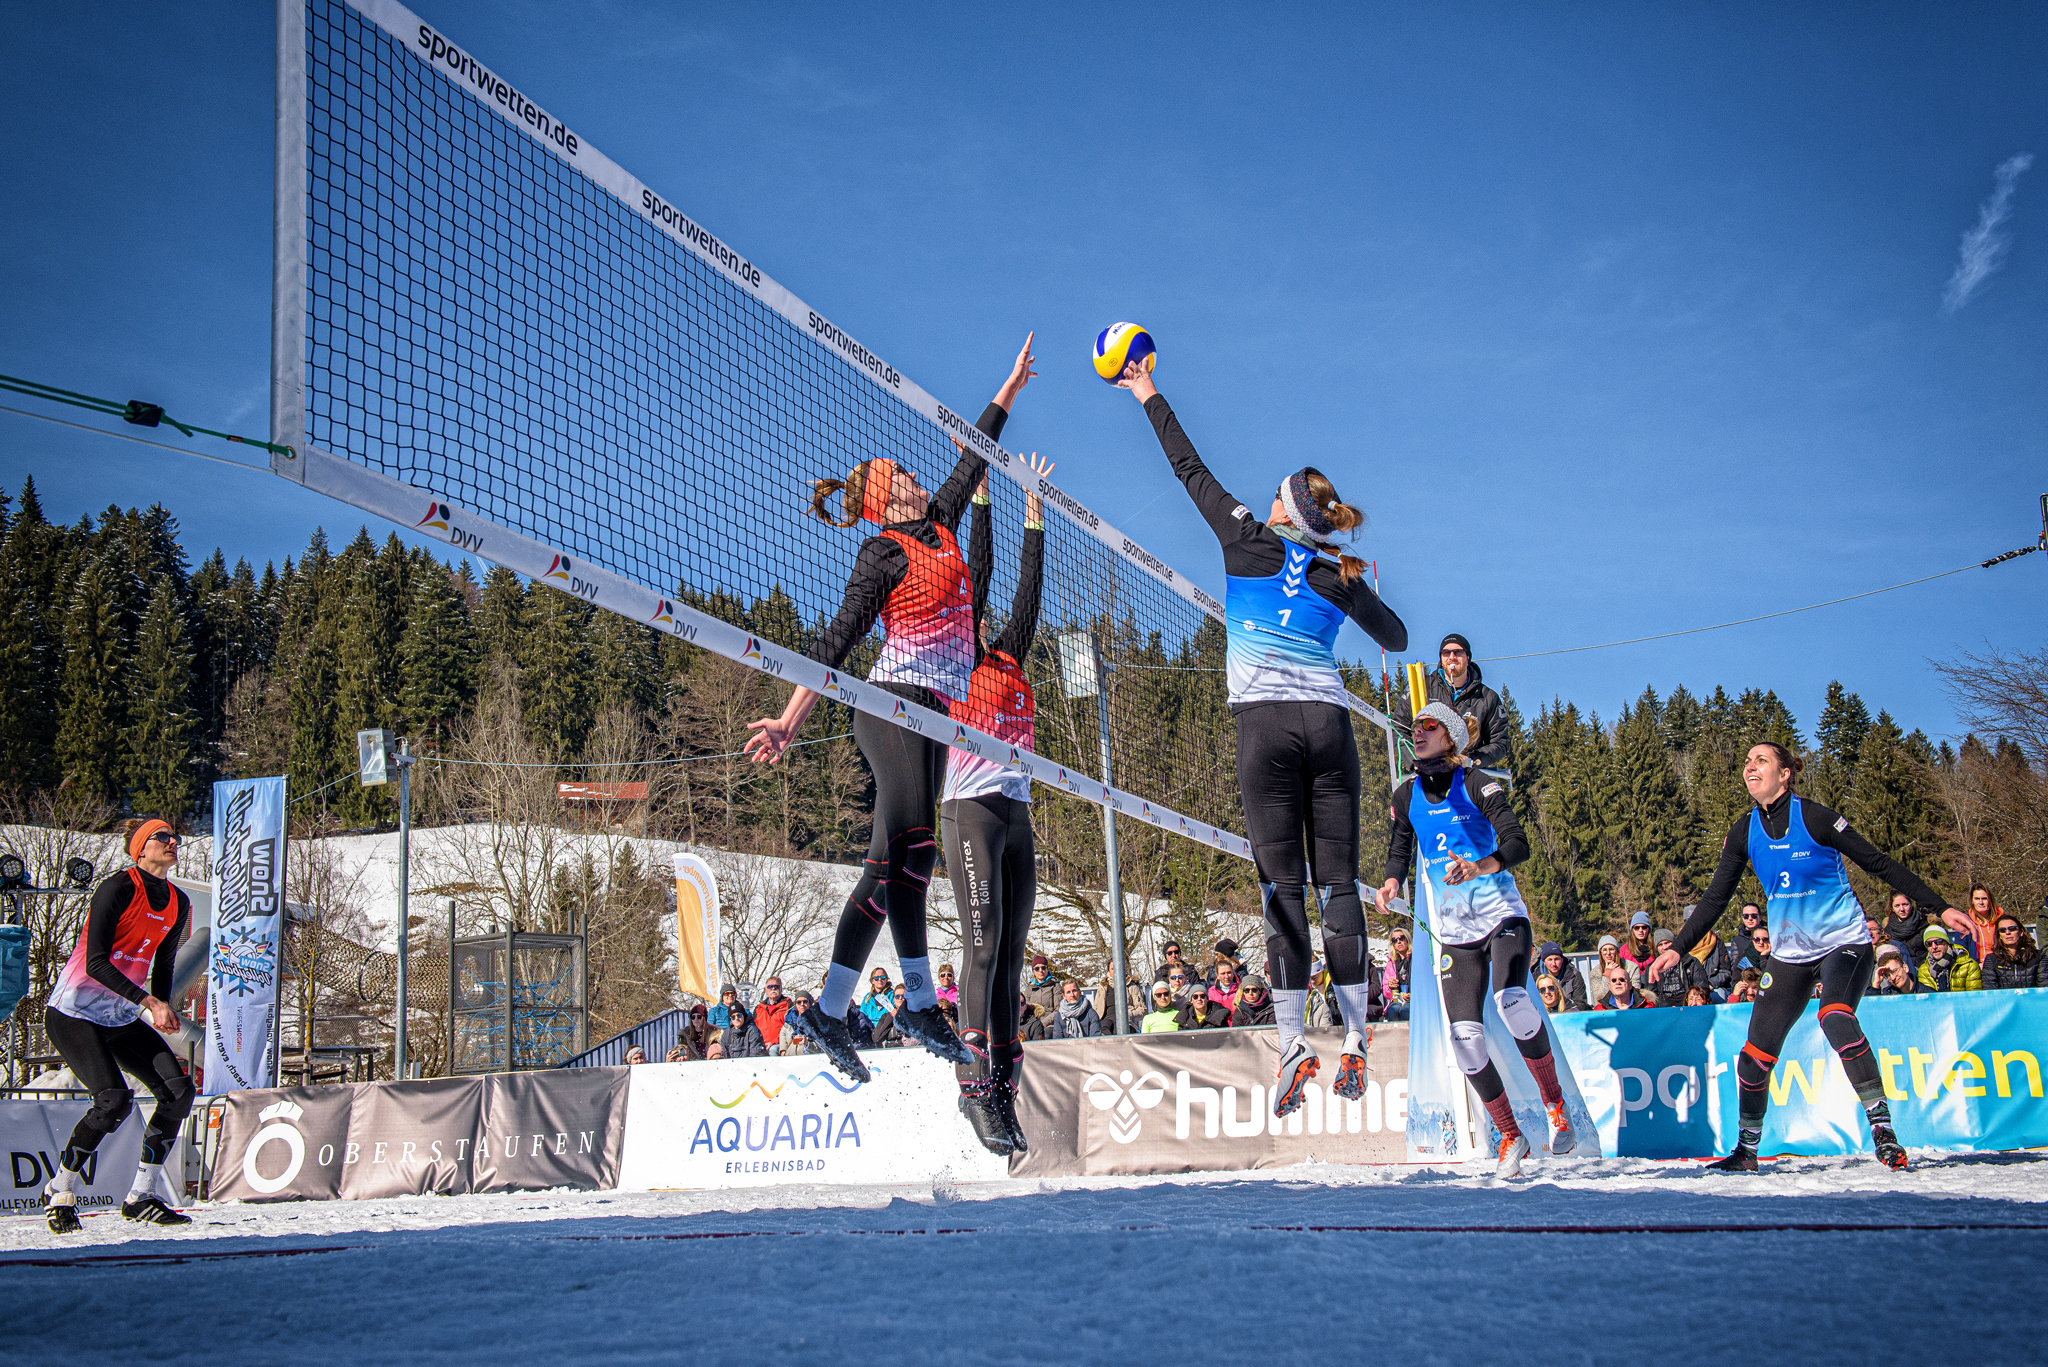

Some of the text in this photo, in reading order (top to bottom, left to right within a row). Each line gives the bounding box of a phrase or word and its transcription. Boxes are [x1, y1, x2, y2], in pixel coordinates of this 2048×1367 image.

[418, 24, 578, 157] sportwetten.de
[642, 189, 761, 289] sportwetten.de
[808, 310, 901, 389] sportwetten.de
[937, 404, 1011, 468] sportwetten.de
[1038, 478, 1099, 531] sportwetten.de
[450, 526, 484, 553] DVV
[1122, 538, 1174, 582] sportwetten.de
[570, 576, 599, 600] DVV
[959, 576, 968, 597] 4
[1277, 608, 1293, 627] 1
[674, 619, 698, 641] DVV
[761, 655, 783, 675] DVV
[839, 687, 858, 706] DVV
[1015, 691, 1025, 710] 3
[907, 715, 923, 732] DVV
[966, 739, 982, 755] DVV
[1020, 761, 1034, 775] DVV
[1068, 781, 1081, 794] DVV
[1112, 798, 1123, 810] DVV
[1436, 832, 1447, 851] 2
[1779, 871, 1791, 888] 3
[963, 840, 984, 947] DSHS SnowTrex
[978, 880, 990, 905] Köln
[1774, 889, 1817, 899] sportwetten.de
[1504, 1000, 1519, 1009] MIKASA
[1575, 1047, 2045, 1128] sporwtten
[1175, 1069, 1408, 1140] humme
[689, 1111, 861, 1155] AQUARIA
[318, 1131, 594, 1166] OBERSTAUFEN
[725, 1159, 826, 1174] ERLEBNISBAD
